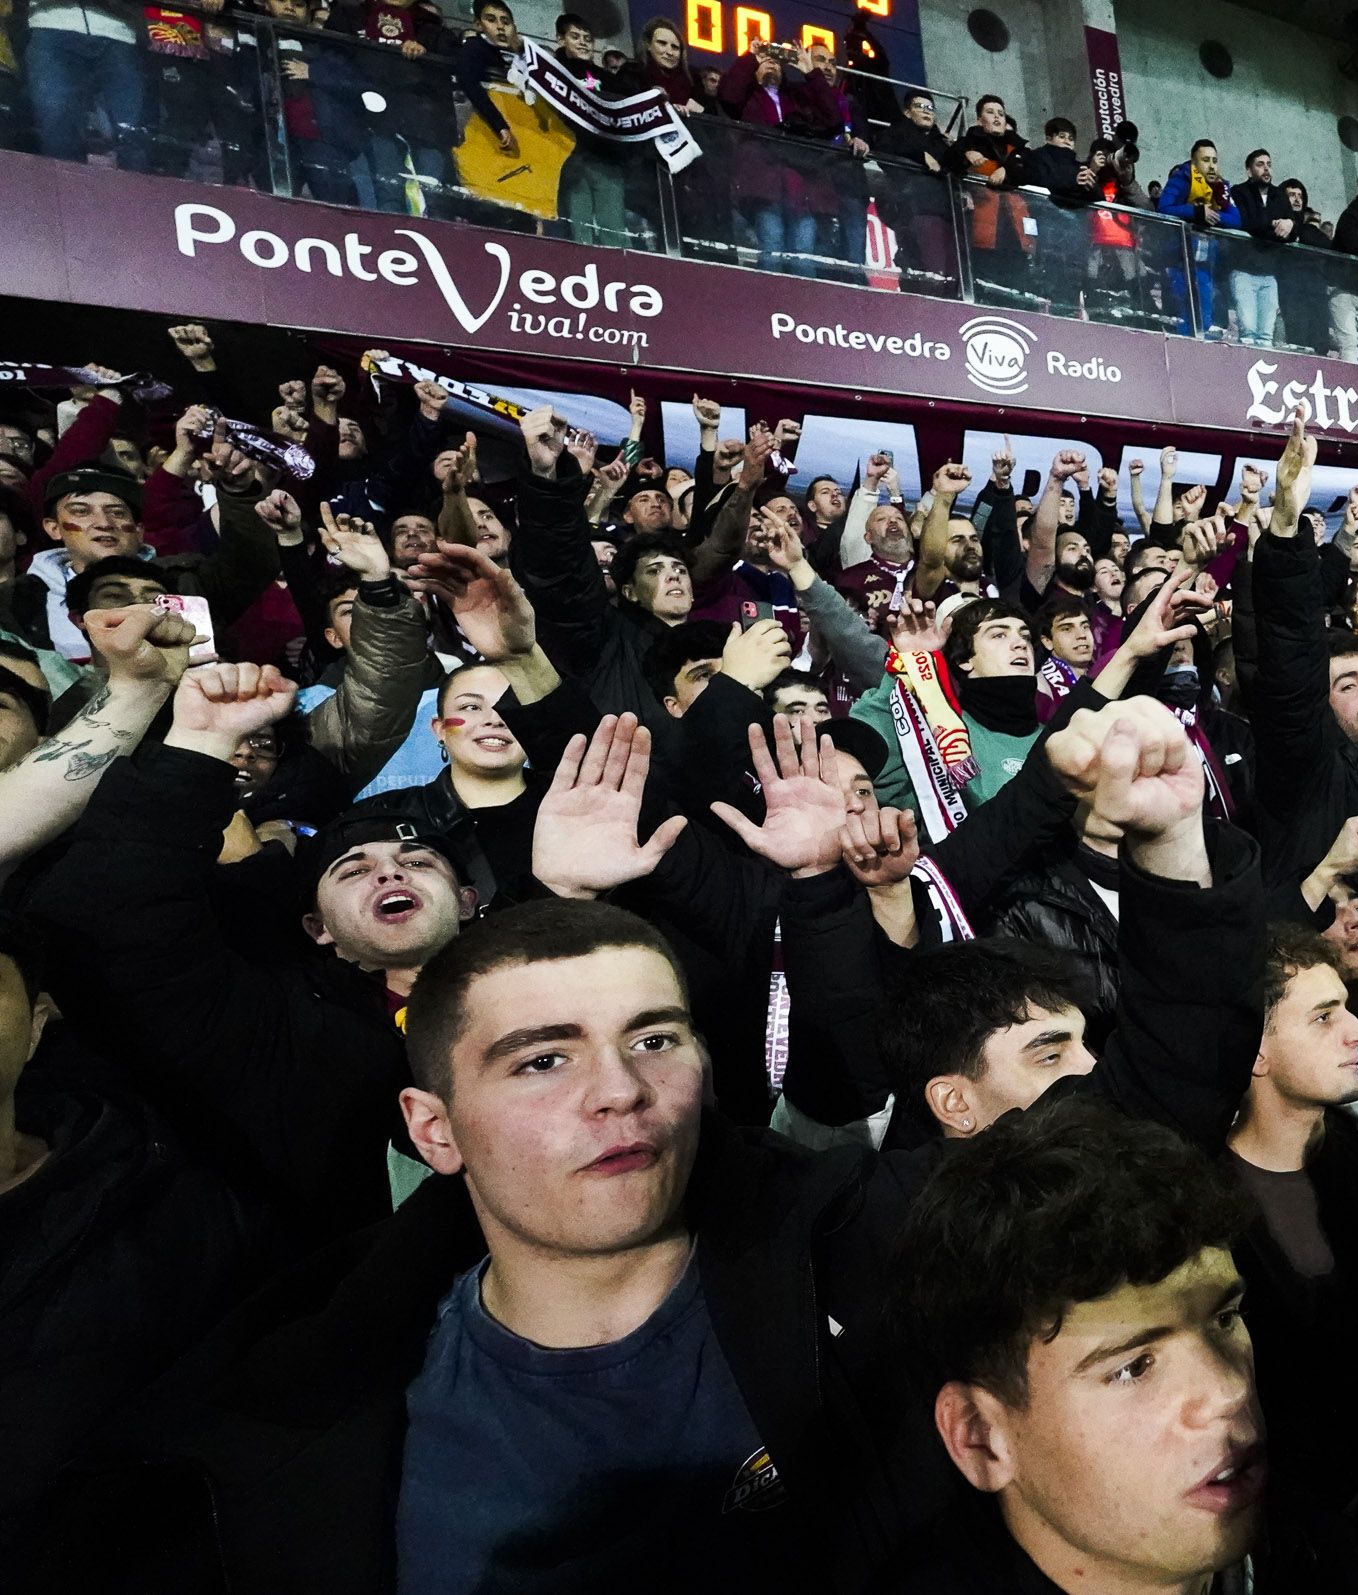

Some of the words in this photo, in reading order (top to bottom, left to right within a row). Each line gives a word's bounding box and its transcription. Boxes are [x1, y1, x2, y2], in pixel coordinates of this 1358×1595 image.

[1093, 68, 1117, 142] eputación
[1108, 71, 1124, 128] evedra
[174, 203, 663, 334] PonteVedra
[770, 312, 952, 361] Pontevedra
[970, 342, 1022, 371] Viva
[1046, 351, 1122, 383] Radio
[1041, 657, 1072, 698] DRA
[923, 737, 959, 806] MUNICIPAL
